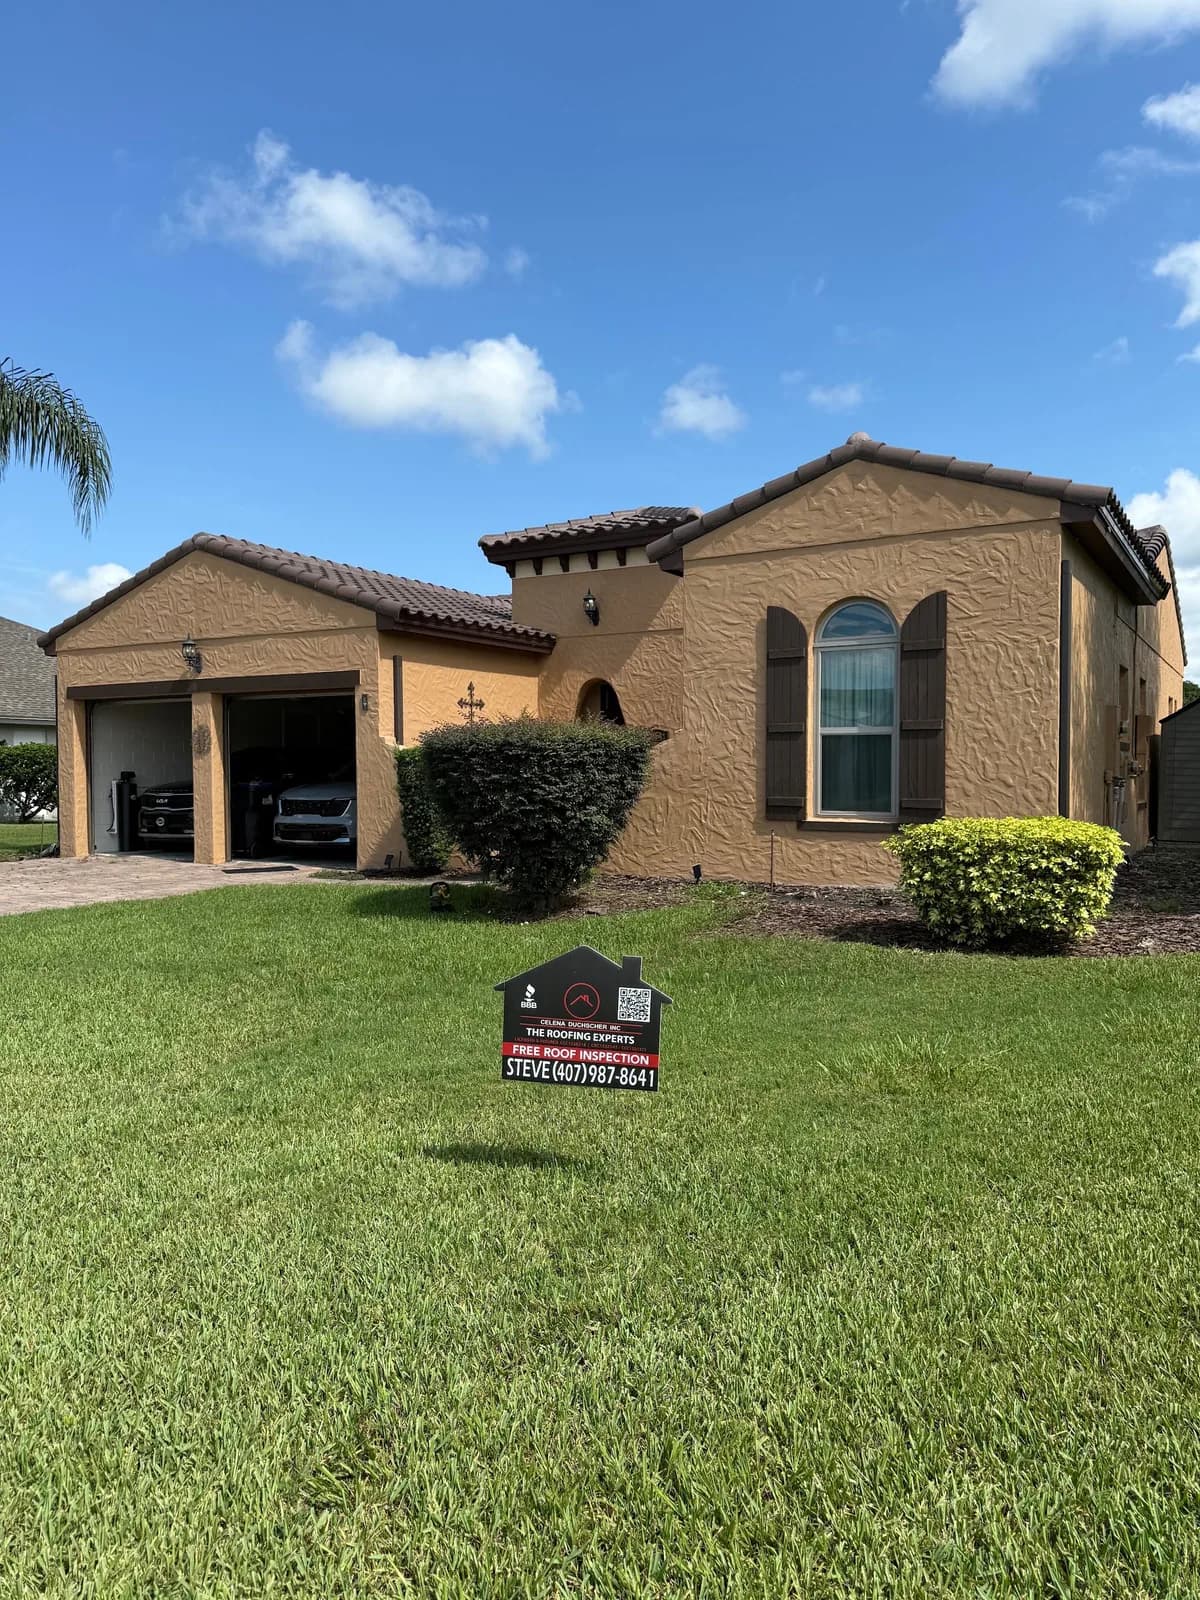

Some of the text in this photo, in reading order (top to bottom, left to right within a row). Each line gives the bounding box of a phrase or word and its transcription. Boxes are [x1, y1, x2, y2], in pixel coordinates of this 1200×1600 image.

[568, 1021, 607, 1030] DUCHSCHER
[526, 1027, 544, 1037] THE
[547, 1029, 590, 1041] ROOFING
[593, 1034, 635, 1044] EXPERTS
[512, 1044, 649, 1065] FREE ROOF INSPECTION
[506, 1058, 550, 1079] STEVE
